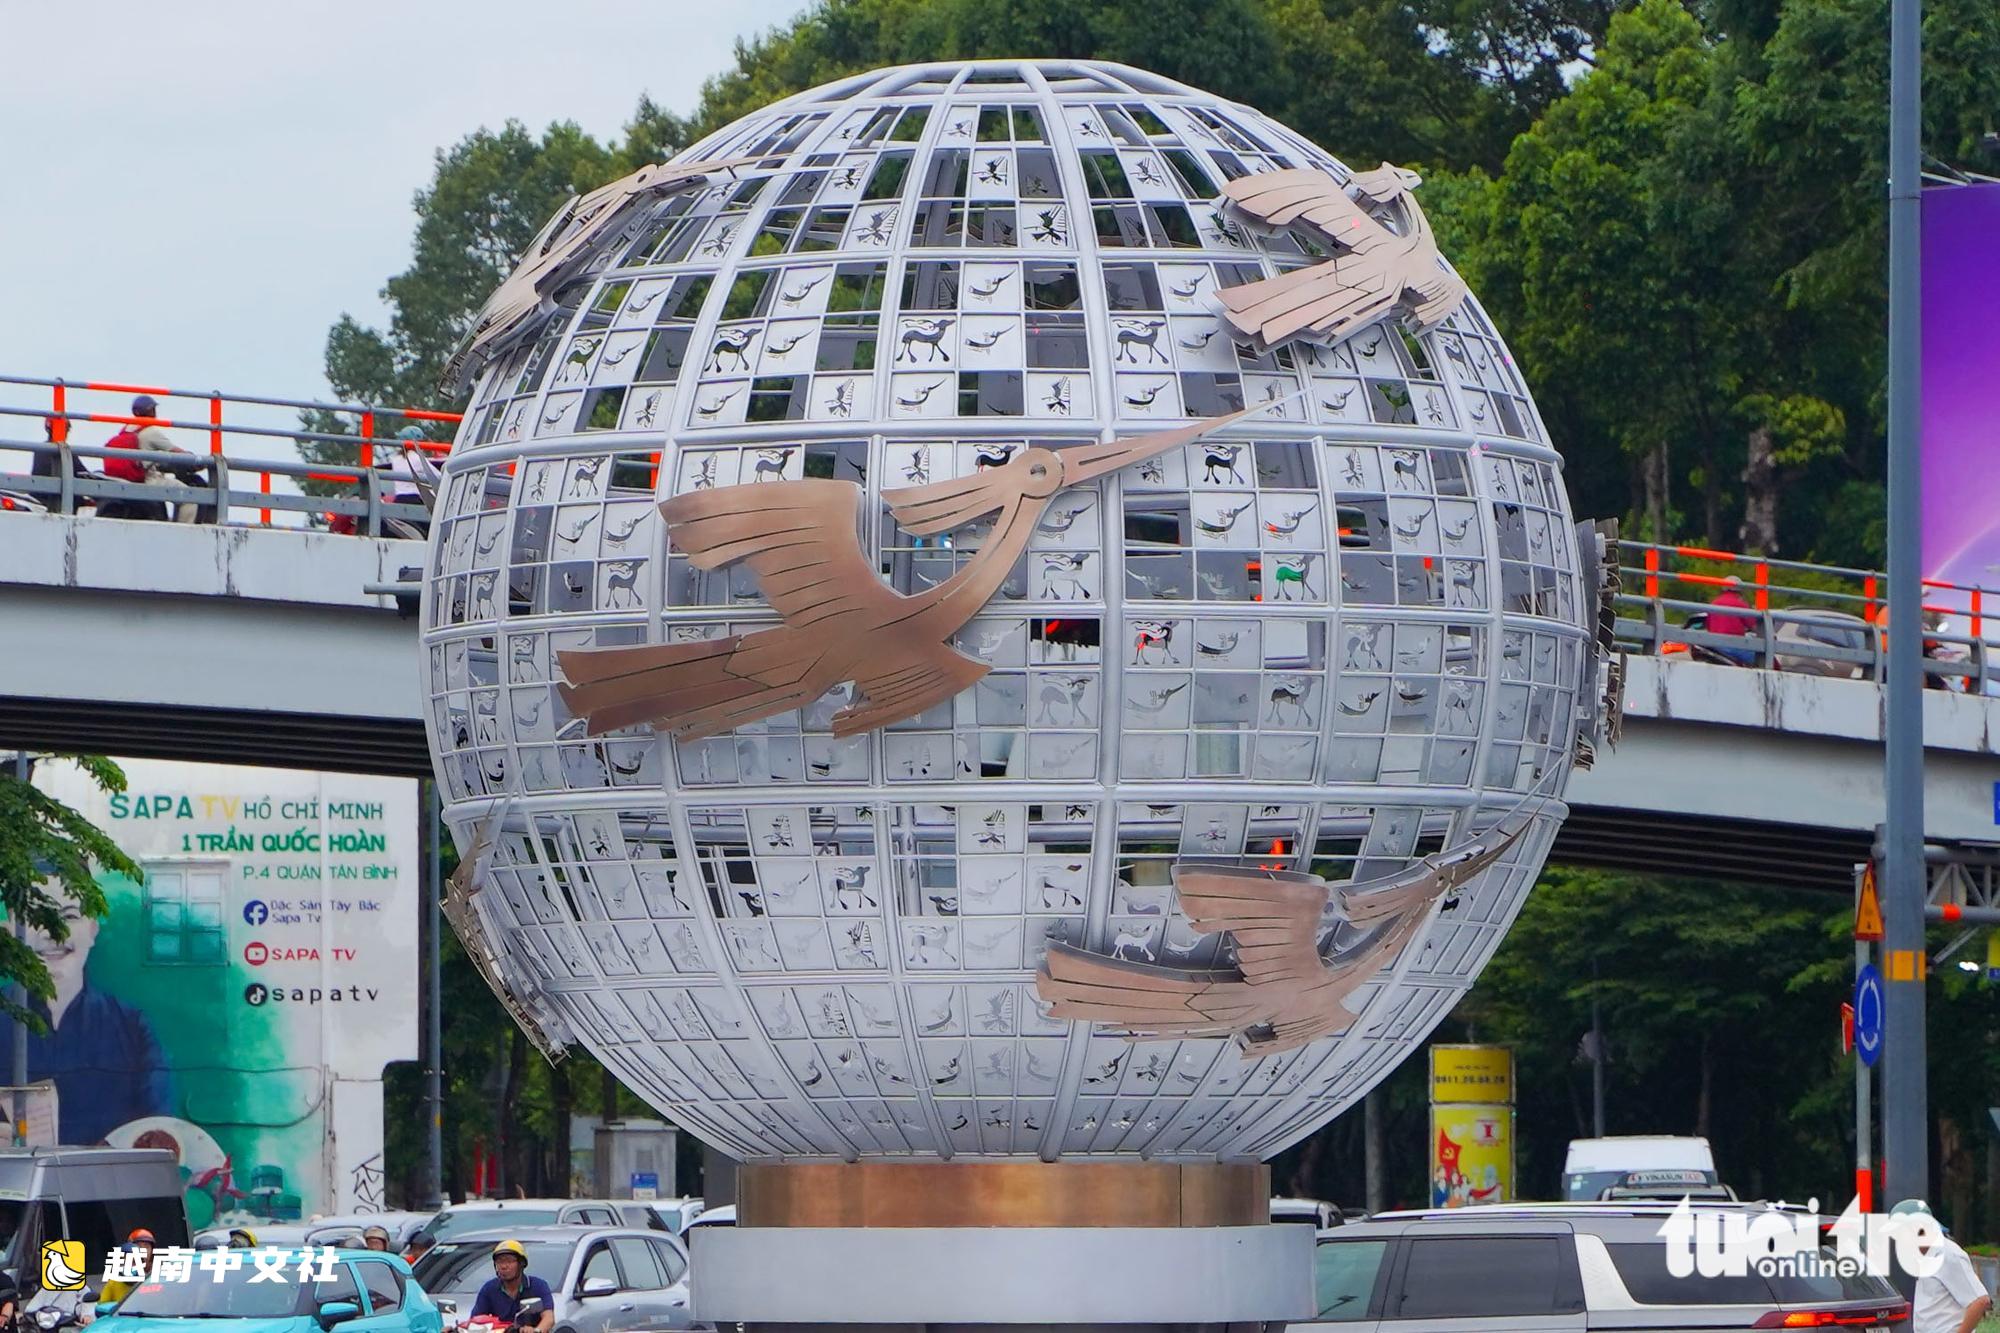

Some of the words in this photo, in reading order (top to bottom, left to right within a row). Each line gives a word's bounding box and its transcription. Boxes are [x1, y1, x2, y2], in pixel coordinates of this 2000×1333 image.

[110, 794, 194, 819] SAPA
[199, 795, 240, 818] TV
[328, 802, 383, 819] MINH
[182, 834, 193, 852] 1
[262, 826, 320, 852] QUỐC
[328, 828, 386, 852] HOÀN
[243, 865, 270, 880] P.4
[272, 913, 301, 924] Sapa
[272, 948, 320, 960] SAPA
[331, 948, 356, 960] TV
